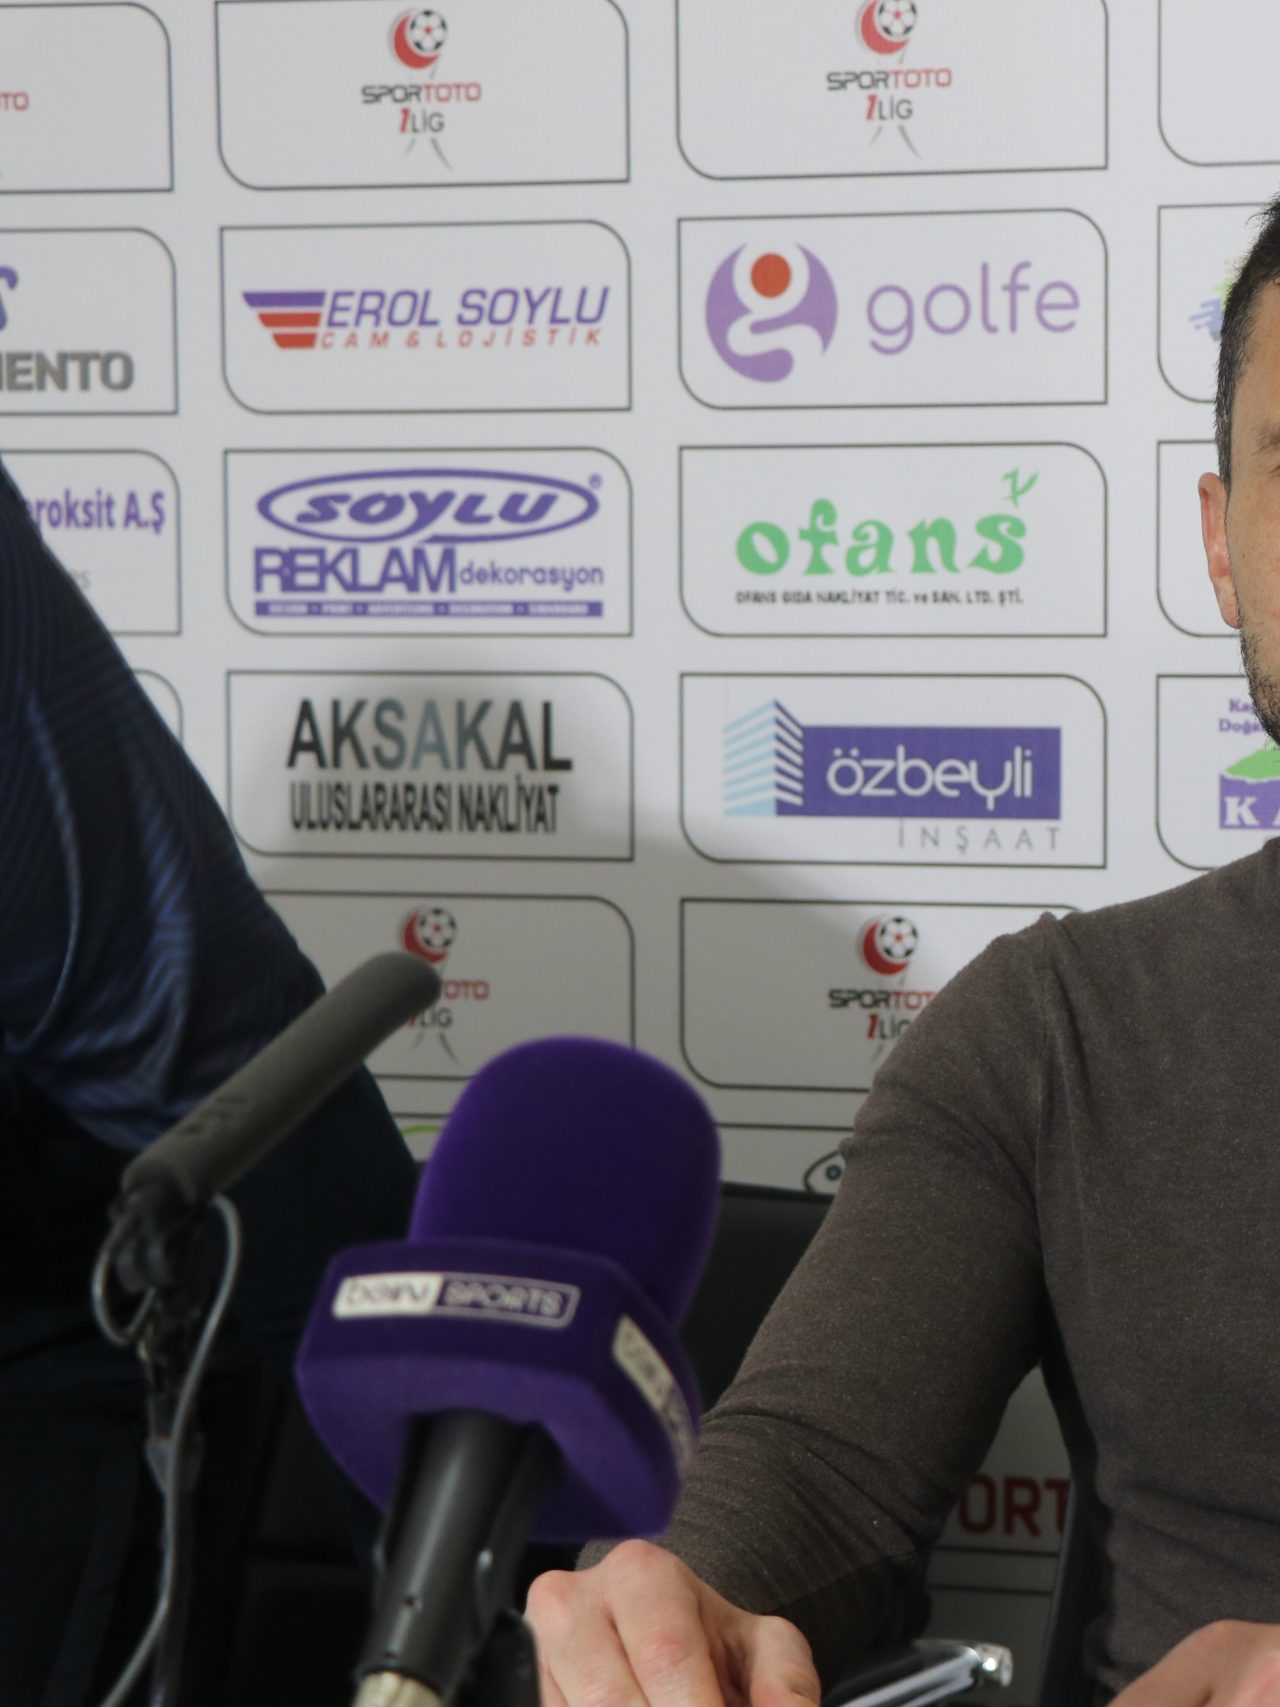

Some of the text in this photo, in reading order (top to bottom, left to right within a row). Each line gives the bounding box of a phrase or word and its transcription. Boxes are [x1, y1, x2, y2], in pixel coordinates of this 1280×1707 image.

[361, 81, 482, 104] SPORTOTO
[827, 67, 952, 91] SPORTOTO
[0, 91, 29, 111] TO
[326, 286, 610, 328] EROL SOYLU
[867, 260, 1080, 356] golfe
[320, 331, 390, 349] CAM
[436, 326, 603, 349] LOJİSTİK
[0, 352, 134, 392] ENTO
[27, 487, 115, 529] roksit
[296, 489, 559, 532] SOYLU
[736, 497, 1028, 578] ofans
[254, 546, 604, 593] REKLAM dekorasyon
[1219, 718, 1264, 734] Doğa
[1229, 699, 1254, 712] Ka
[286, 698, 573, 772] AKSAKAL
[826, 745, 1033, 811] özbeyli
[289, 772, 560, 834] ULUSLARARASI NAKLİYAT
